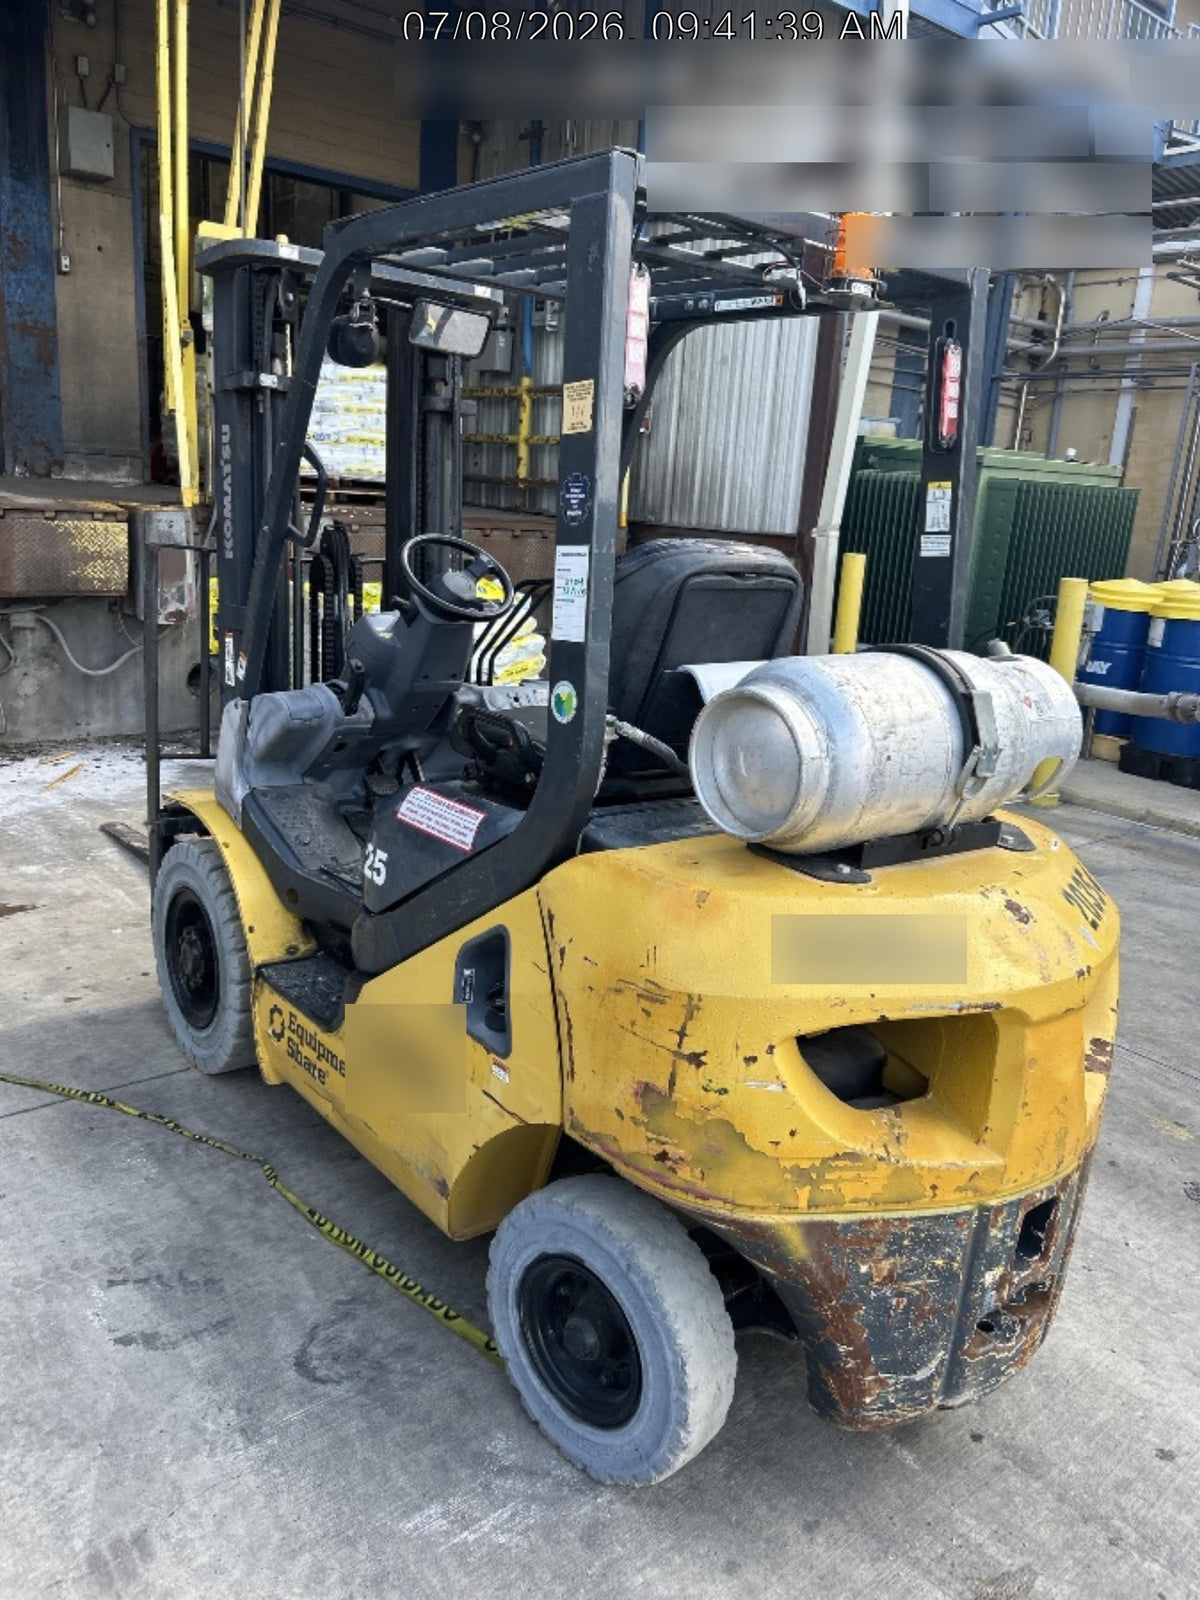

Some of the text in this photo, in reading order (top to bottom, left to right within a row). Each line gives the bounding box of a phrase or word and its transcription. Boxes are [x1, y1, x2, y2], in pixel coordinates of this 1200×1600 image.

[220, 424, 233, 559] KOMATSU
[363, 842, 388, 886] 25
[287, 1011, 346, 1078] Equipme
